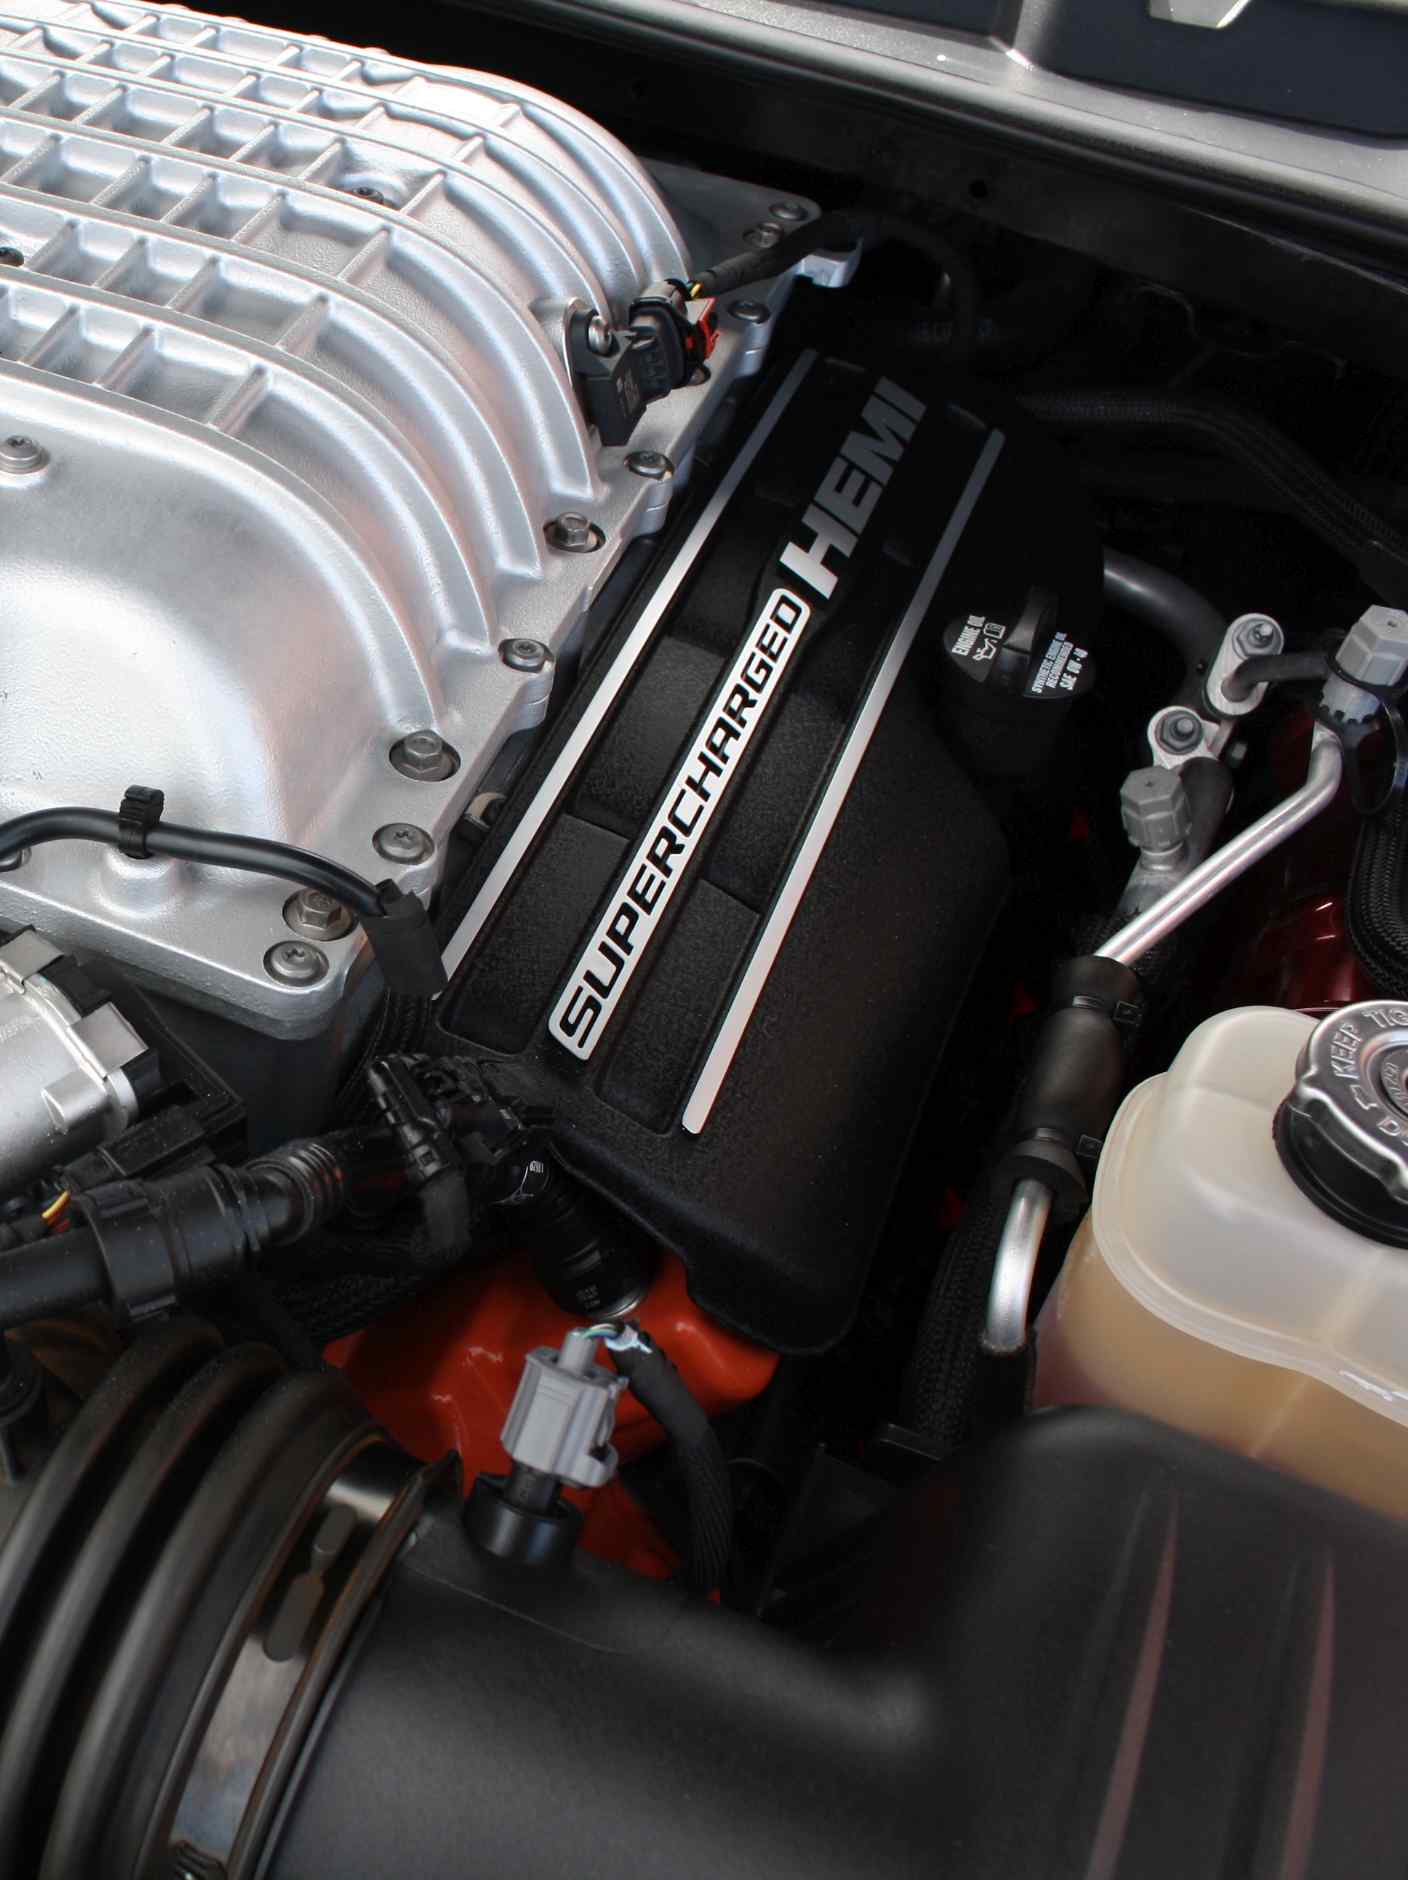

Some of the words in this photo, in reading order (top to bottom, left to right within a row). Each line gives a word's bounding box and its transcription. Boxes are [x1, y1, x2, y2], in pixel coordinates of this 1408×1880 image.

[779, 376, 927, 600] HEMI
[952, 626, 981, 656] ENGINE
[559, 594, 803, 1049] SUPERCHARGED
[1360, 1006, 1408, 1028] TIG
[1331, 1022, 1362, 1079] KEEP
